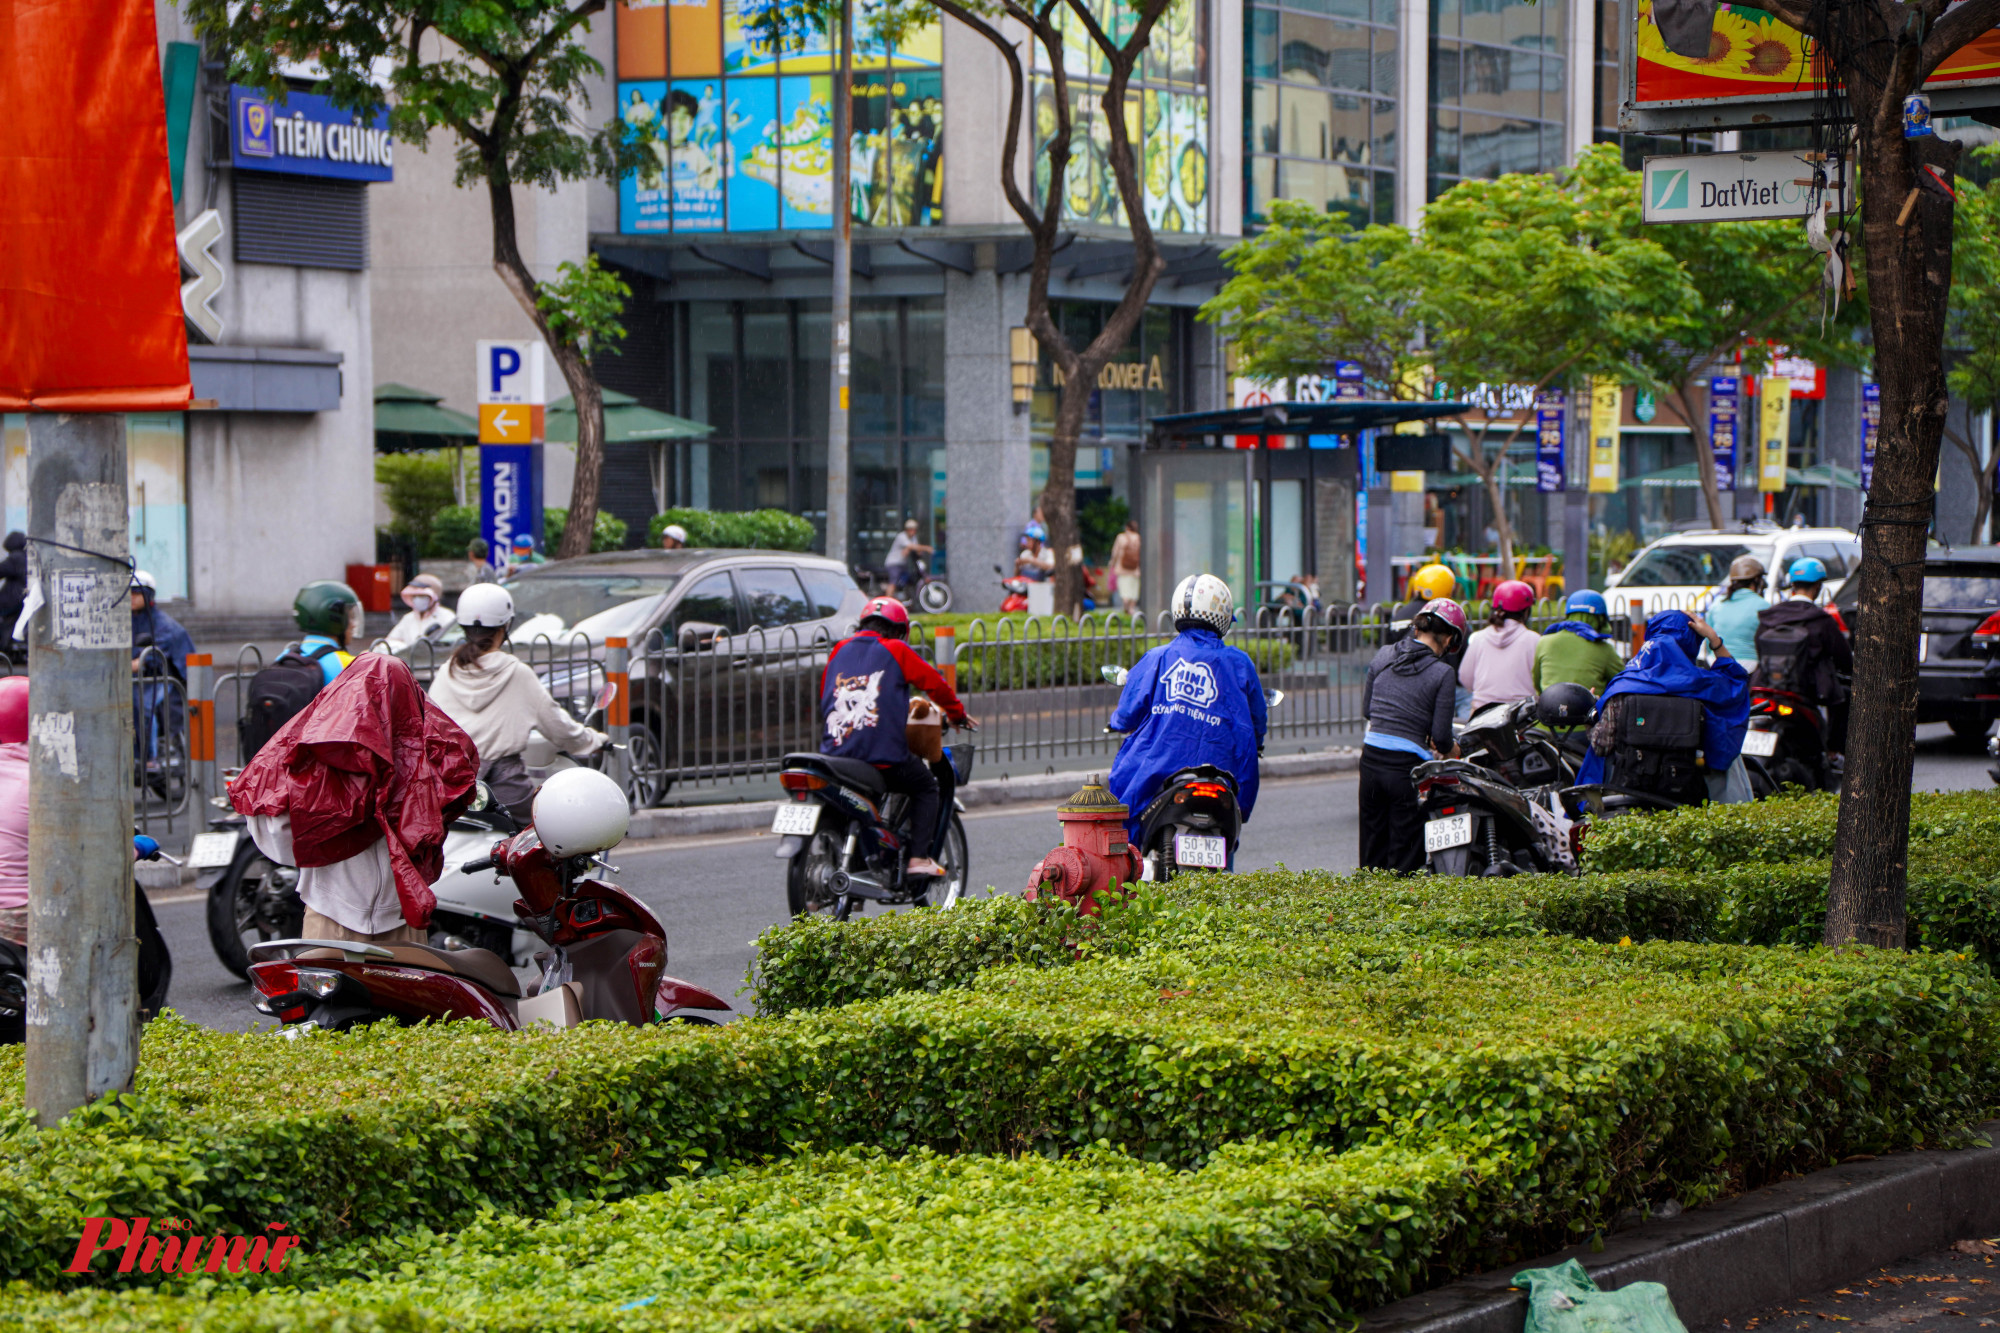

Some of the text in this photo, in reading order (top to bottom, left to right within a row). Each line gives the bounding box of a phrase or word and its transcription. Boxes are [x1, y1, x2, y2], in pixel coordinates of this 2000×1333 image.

[274, 111, 393, 167] TIÊM CHỦNG
[491, 347, 520, 392] P
[1432, 818, 1464, 836] 59-S2
[1184, 837, 1218, 852] 50-N2
[1428, 829, 1467, 850] 988.81
[1181, 850, 1222, 866] 058.50
